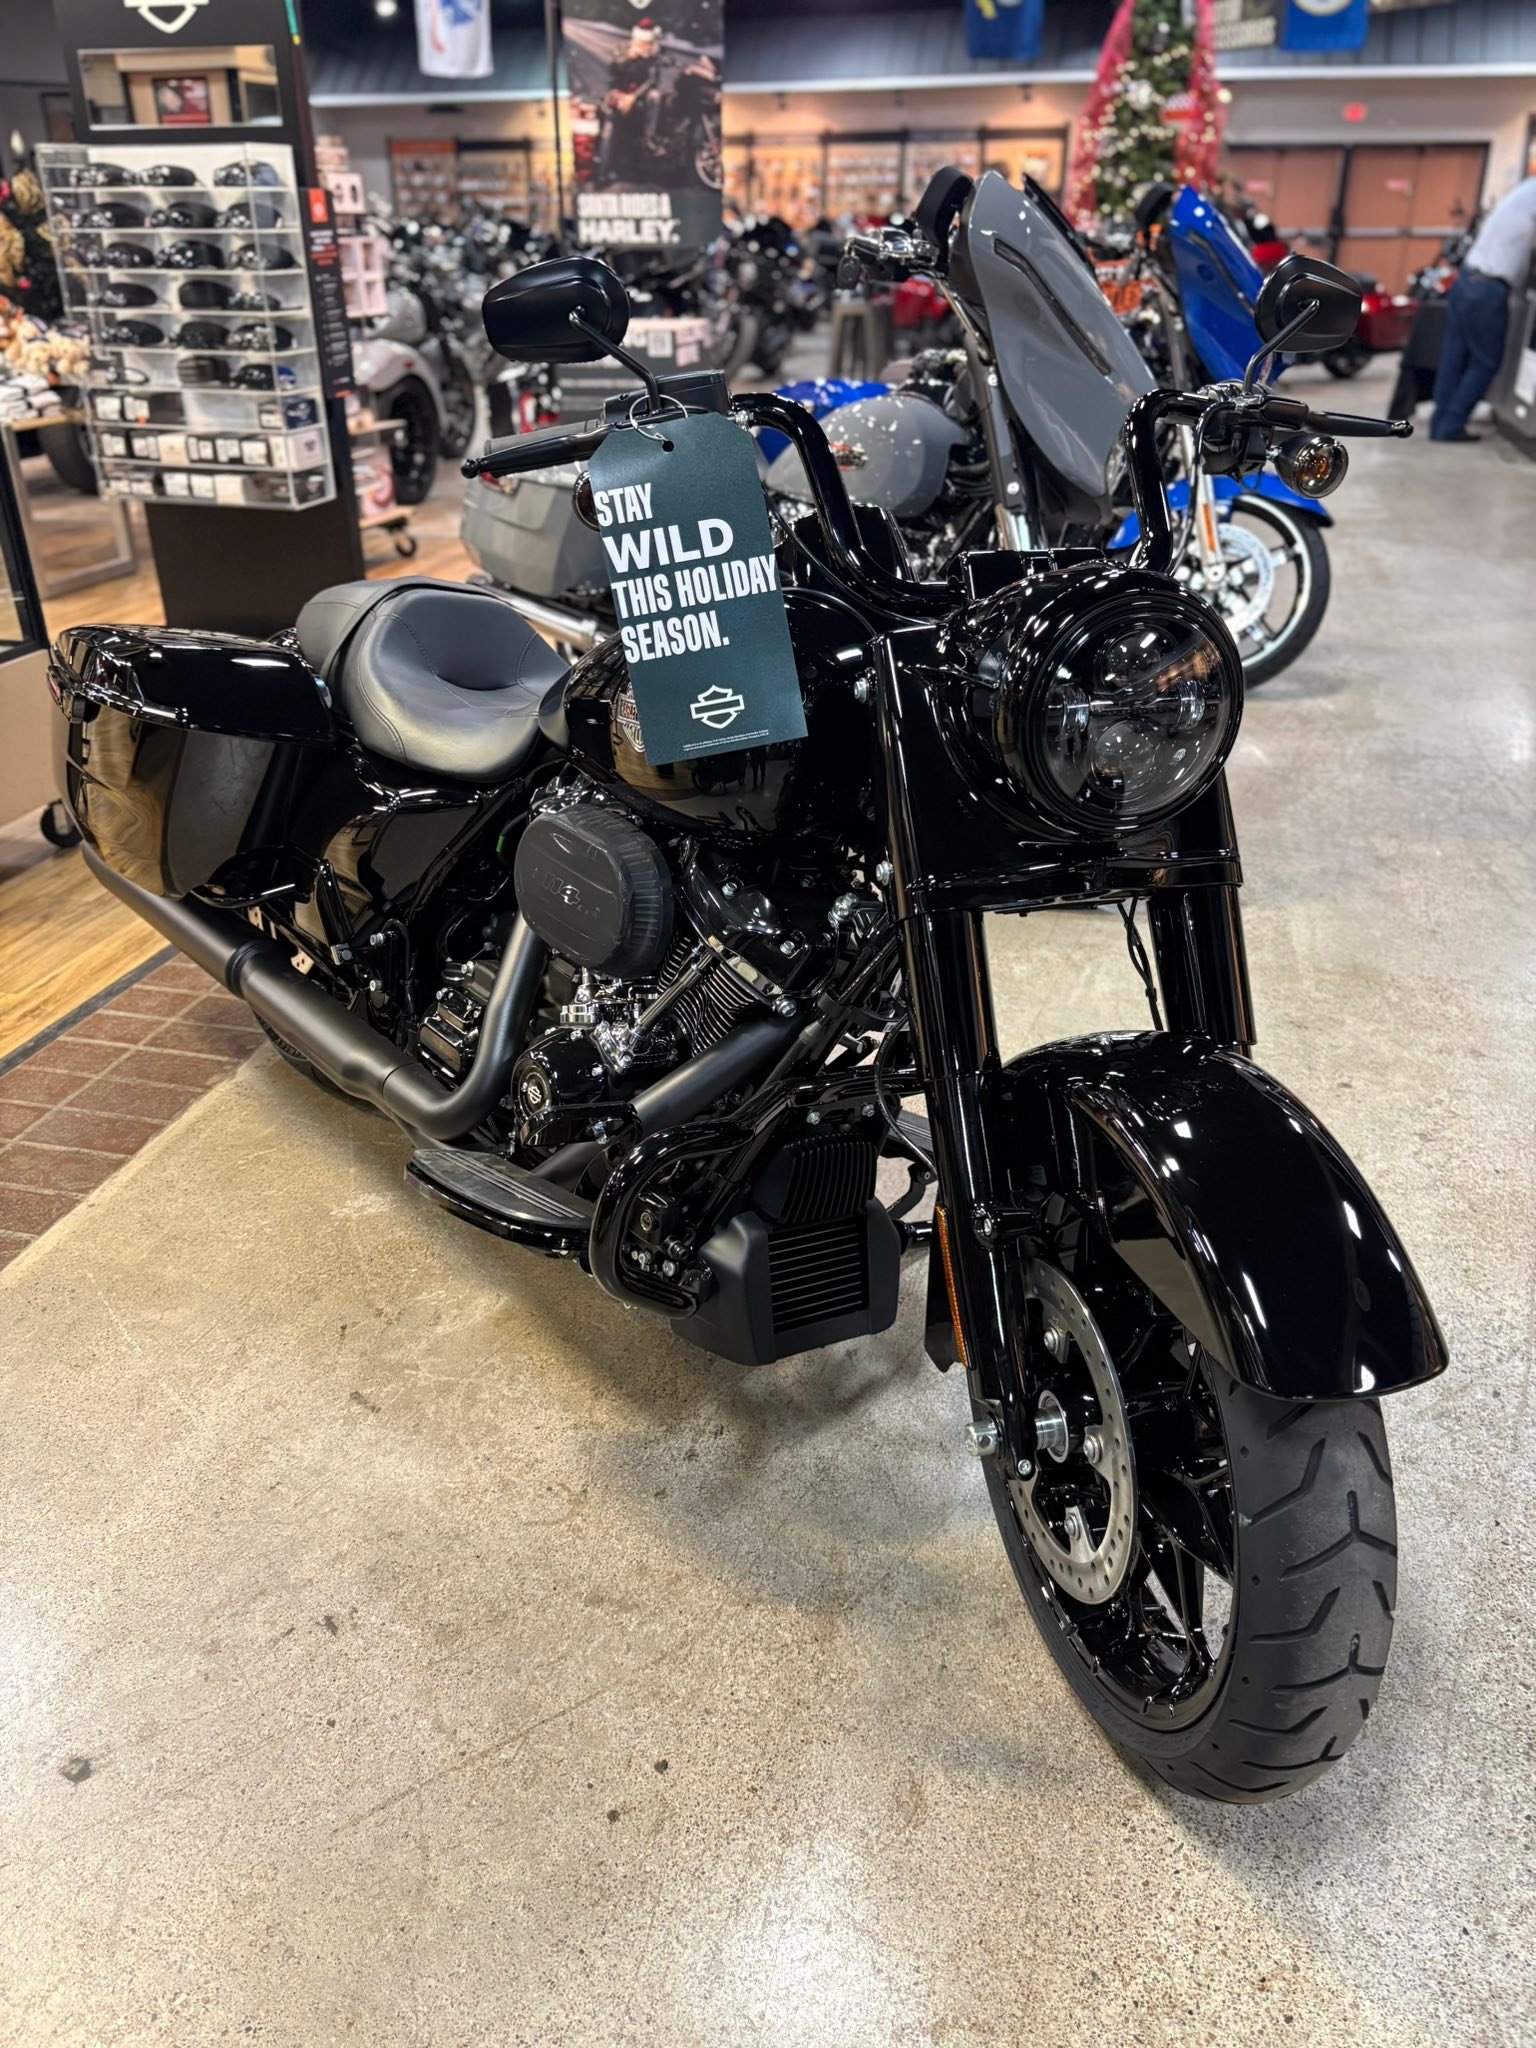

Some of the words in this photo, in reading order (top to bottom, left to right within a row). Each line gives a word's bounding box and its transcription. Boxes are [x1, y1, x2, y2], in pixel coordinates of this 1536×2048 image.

[595, 483, 653, 527] STAY
[602, 518, 734, 574] WILD
[611, 573, 672, 619] THIS
[674, 554, 776, 608] HOLIDAY
[621, 610, 730, 664] SEASON.
